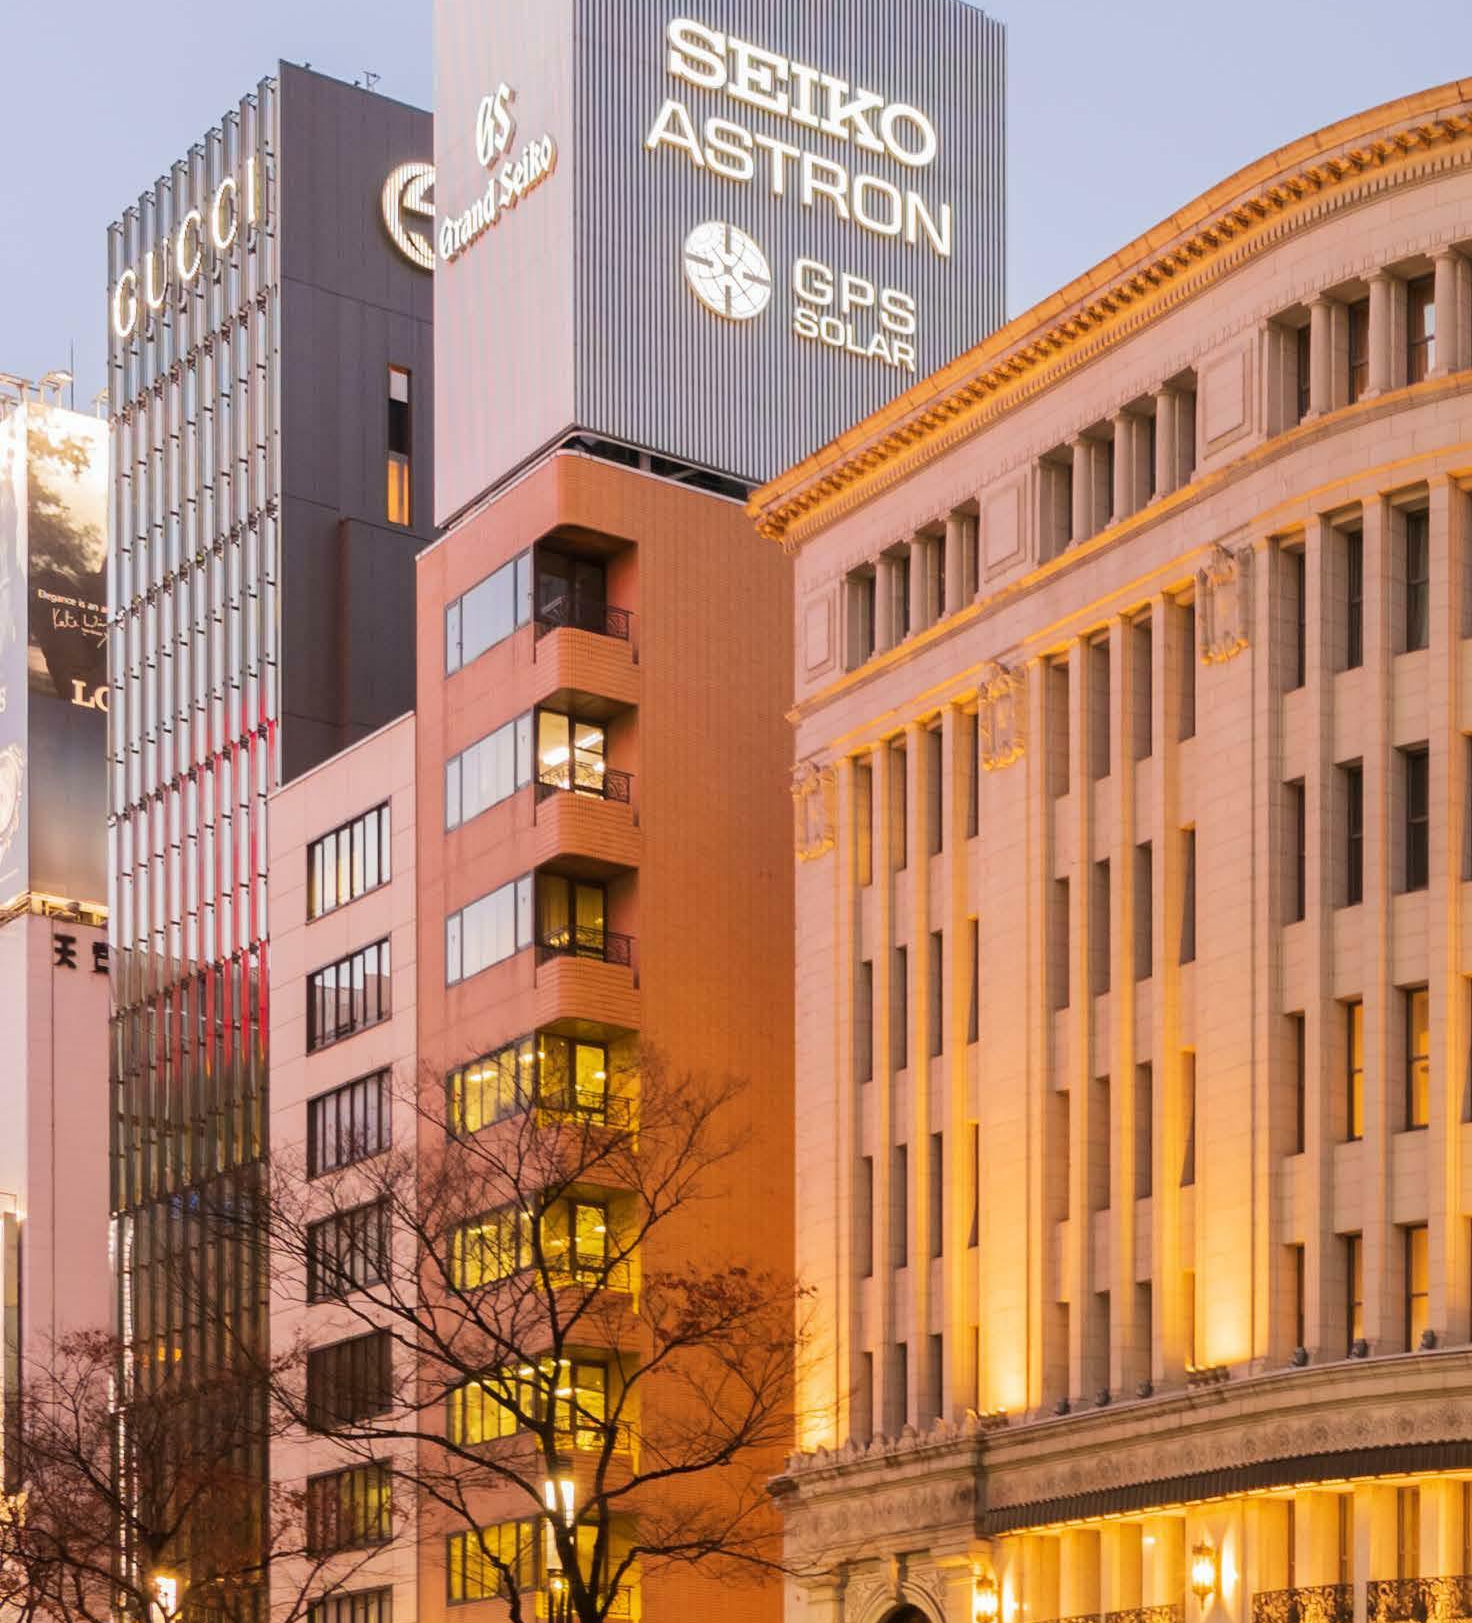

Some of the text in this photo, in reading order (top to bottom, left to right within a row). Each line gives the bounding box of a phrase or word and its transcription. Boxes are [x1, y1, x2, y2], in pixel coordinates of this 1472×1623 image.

[666, 16, 938, 168] SEIKO
[112, 156, 258, 338] GUCCI
[438, 132, 558, 264] Grand Seiko
[644, 97, 953, 259] ASTRON
[792, 256, 917, 337] GPS
[792, 306, 917, 374] SOLAR
